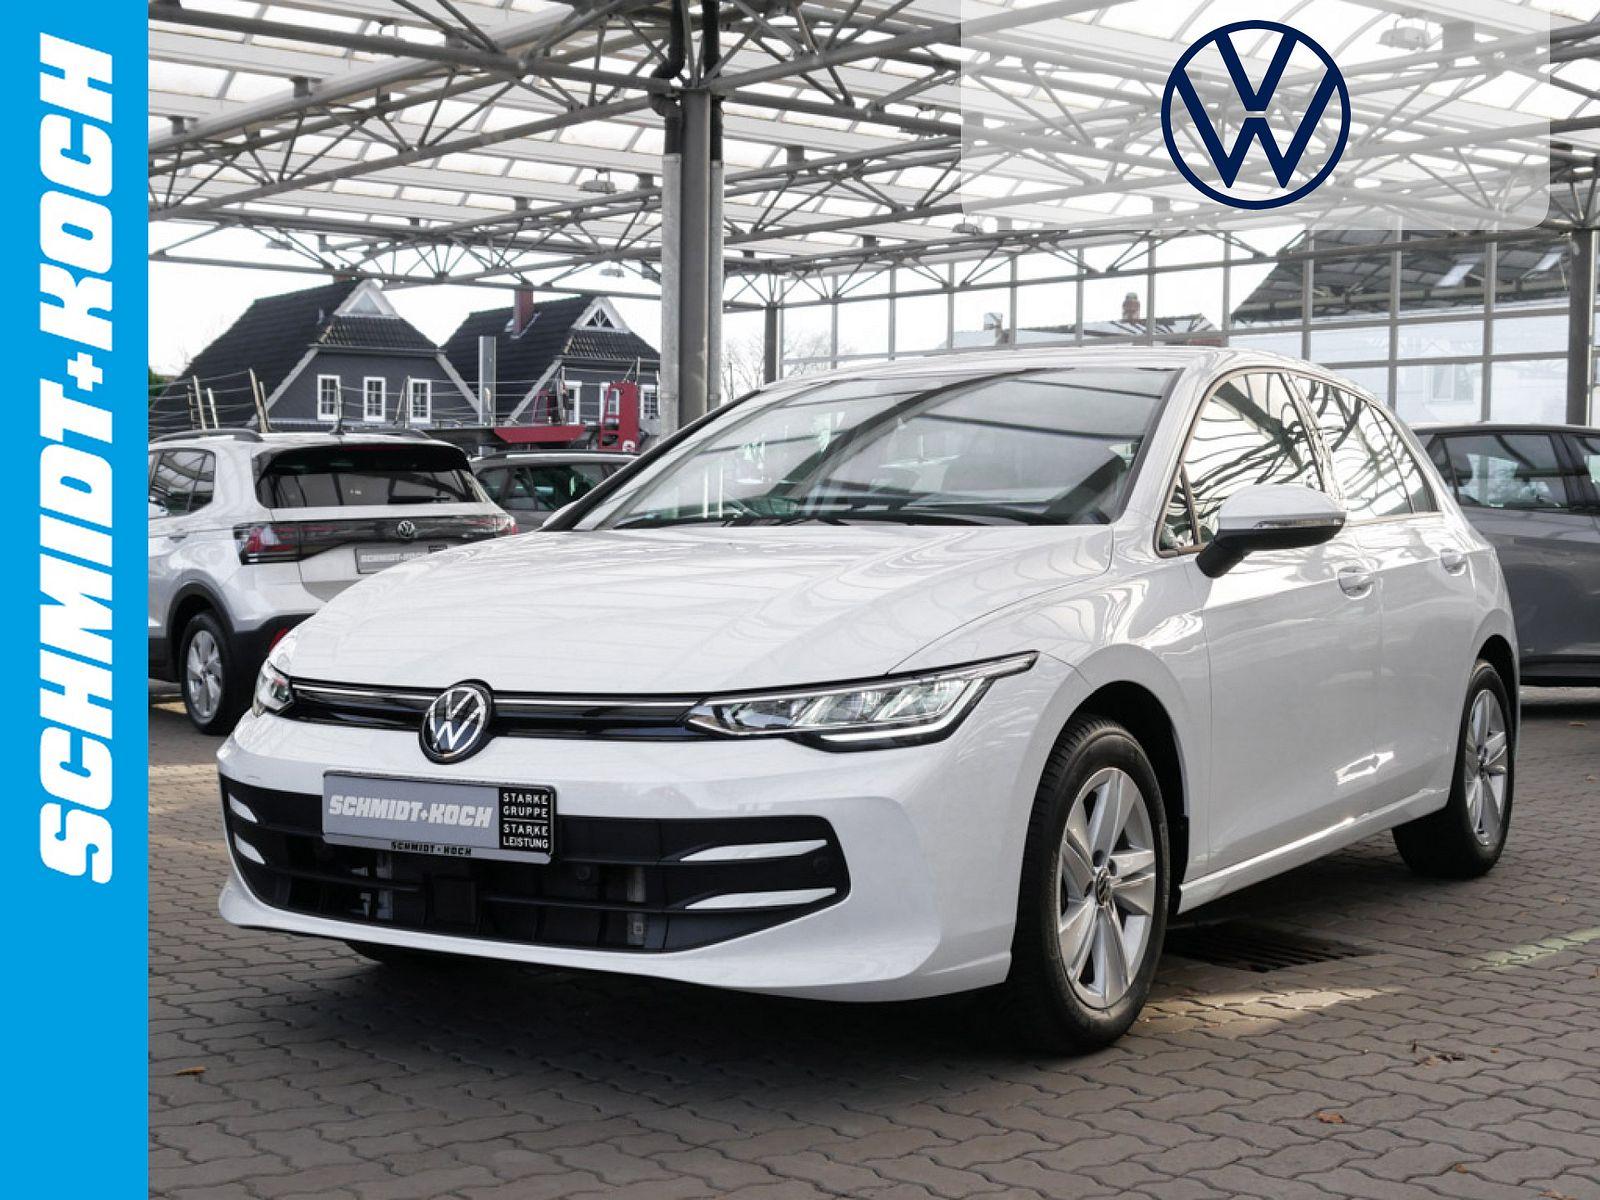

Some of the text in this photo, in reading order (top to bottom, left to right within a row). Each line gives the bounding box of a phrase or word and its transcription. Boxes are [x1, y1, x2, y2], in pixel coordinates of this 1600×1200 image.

[425, 687, 487, 756] VW
[502, 793, 548, 804] STARKE
[502, 806, 548, 818] GRUPPE
[502, 824, 548, 836] STARKE
[503, 837, 549, 849] LEISTUNG
